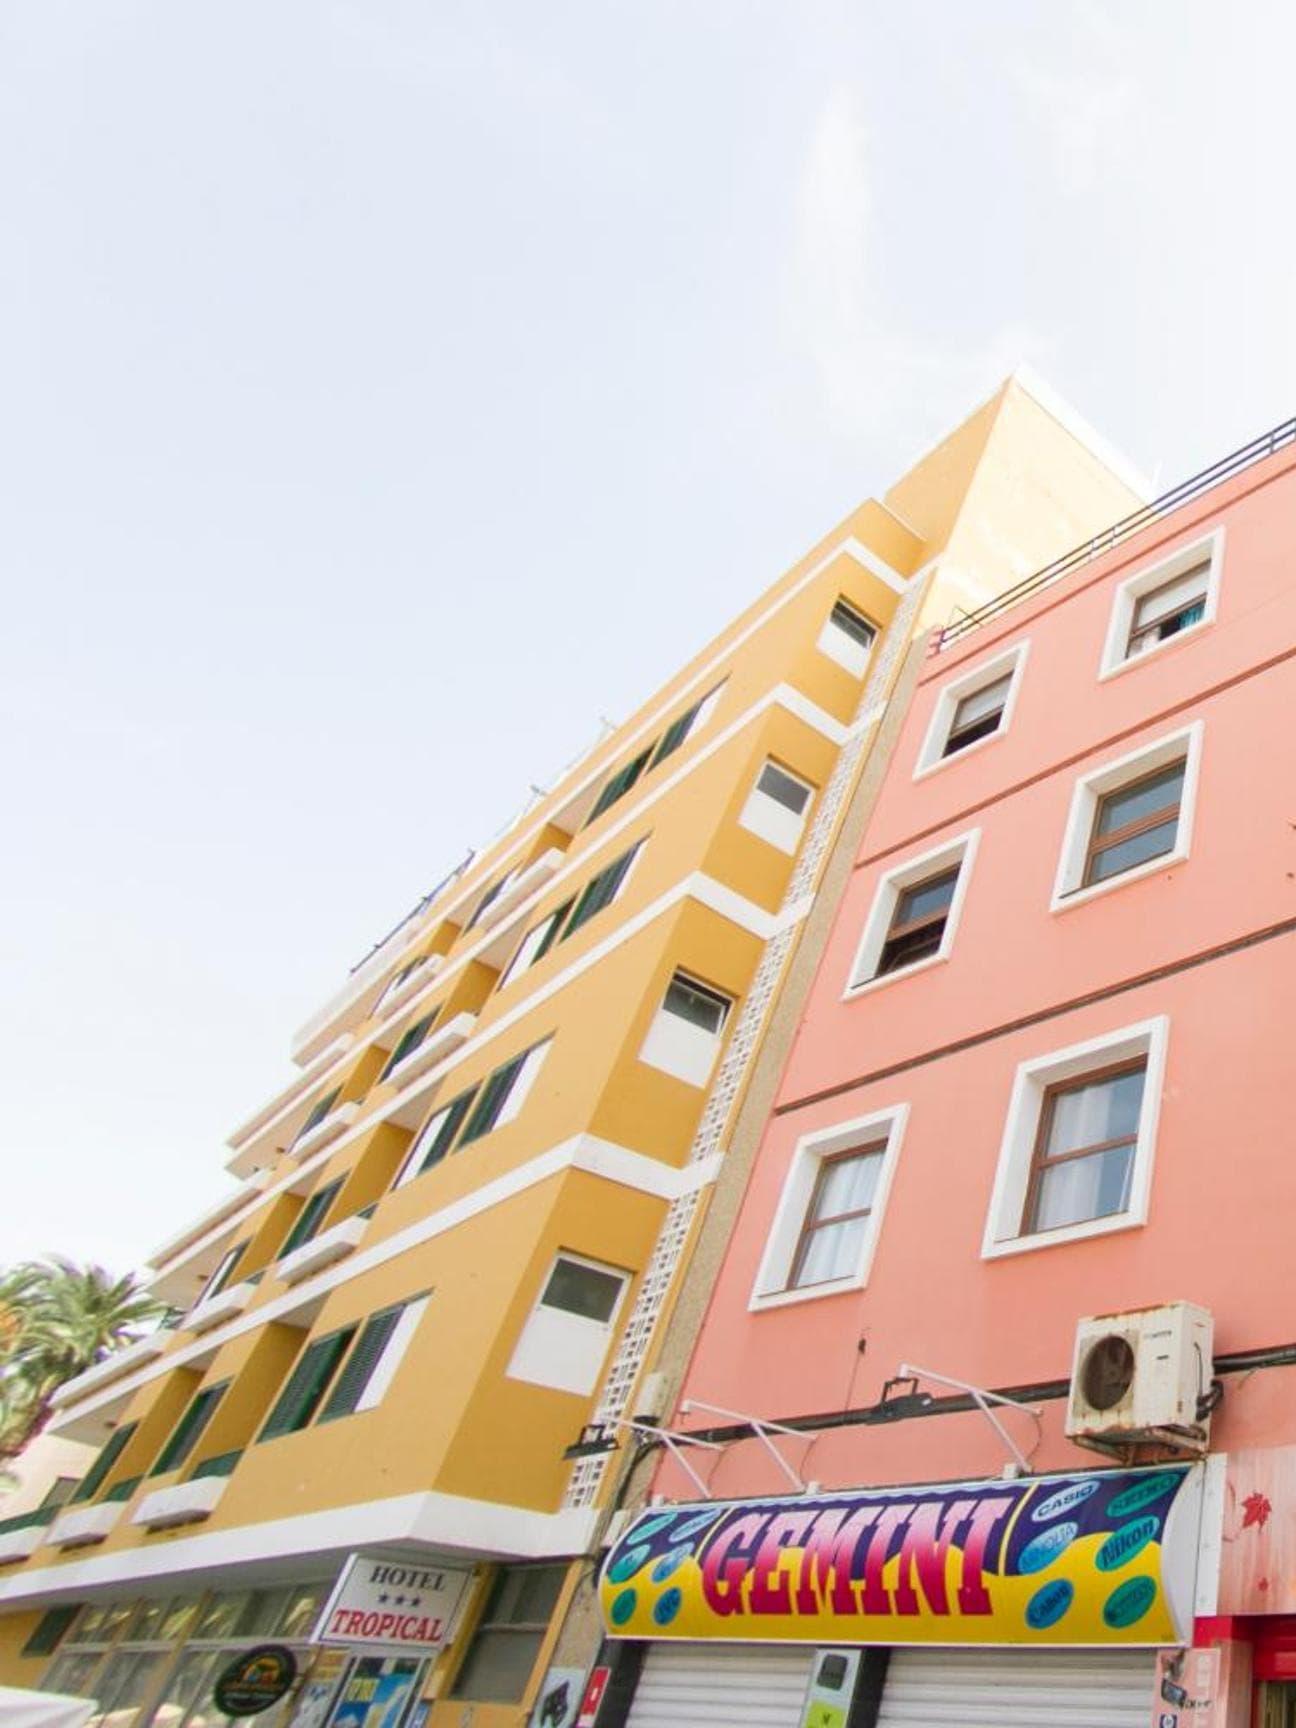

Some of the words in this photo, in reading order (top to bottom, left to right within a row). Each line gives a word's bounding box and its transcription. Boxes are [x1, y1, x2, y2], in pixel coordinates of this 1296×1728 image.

[1037, 1485, 1094, 1517] CASIO
[702, 1497, 1016, 1616] GEMINI
[1101, 1518, 1154, 1568] Nikon
[370, 1565, 446, 1591] HOTEL
[330, 1609, 443, 1642] TROPICAL
